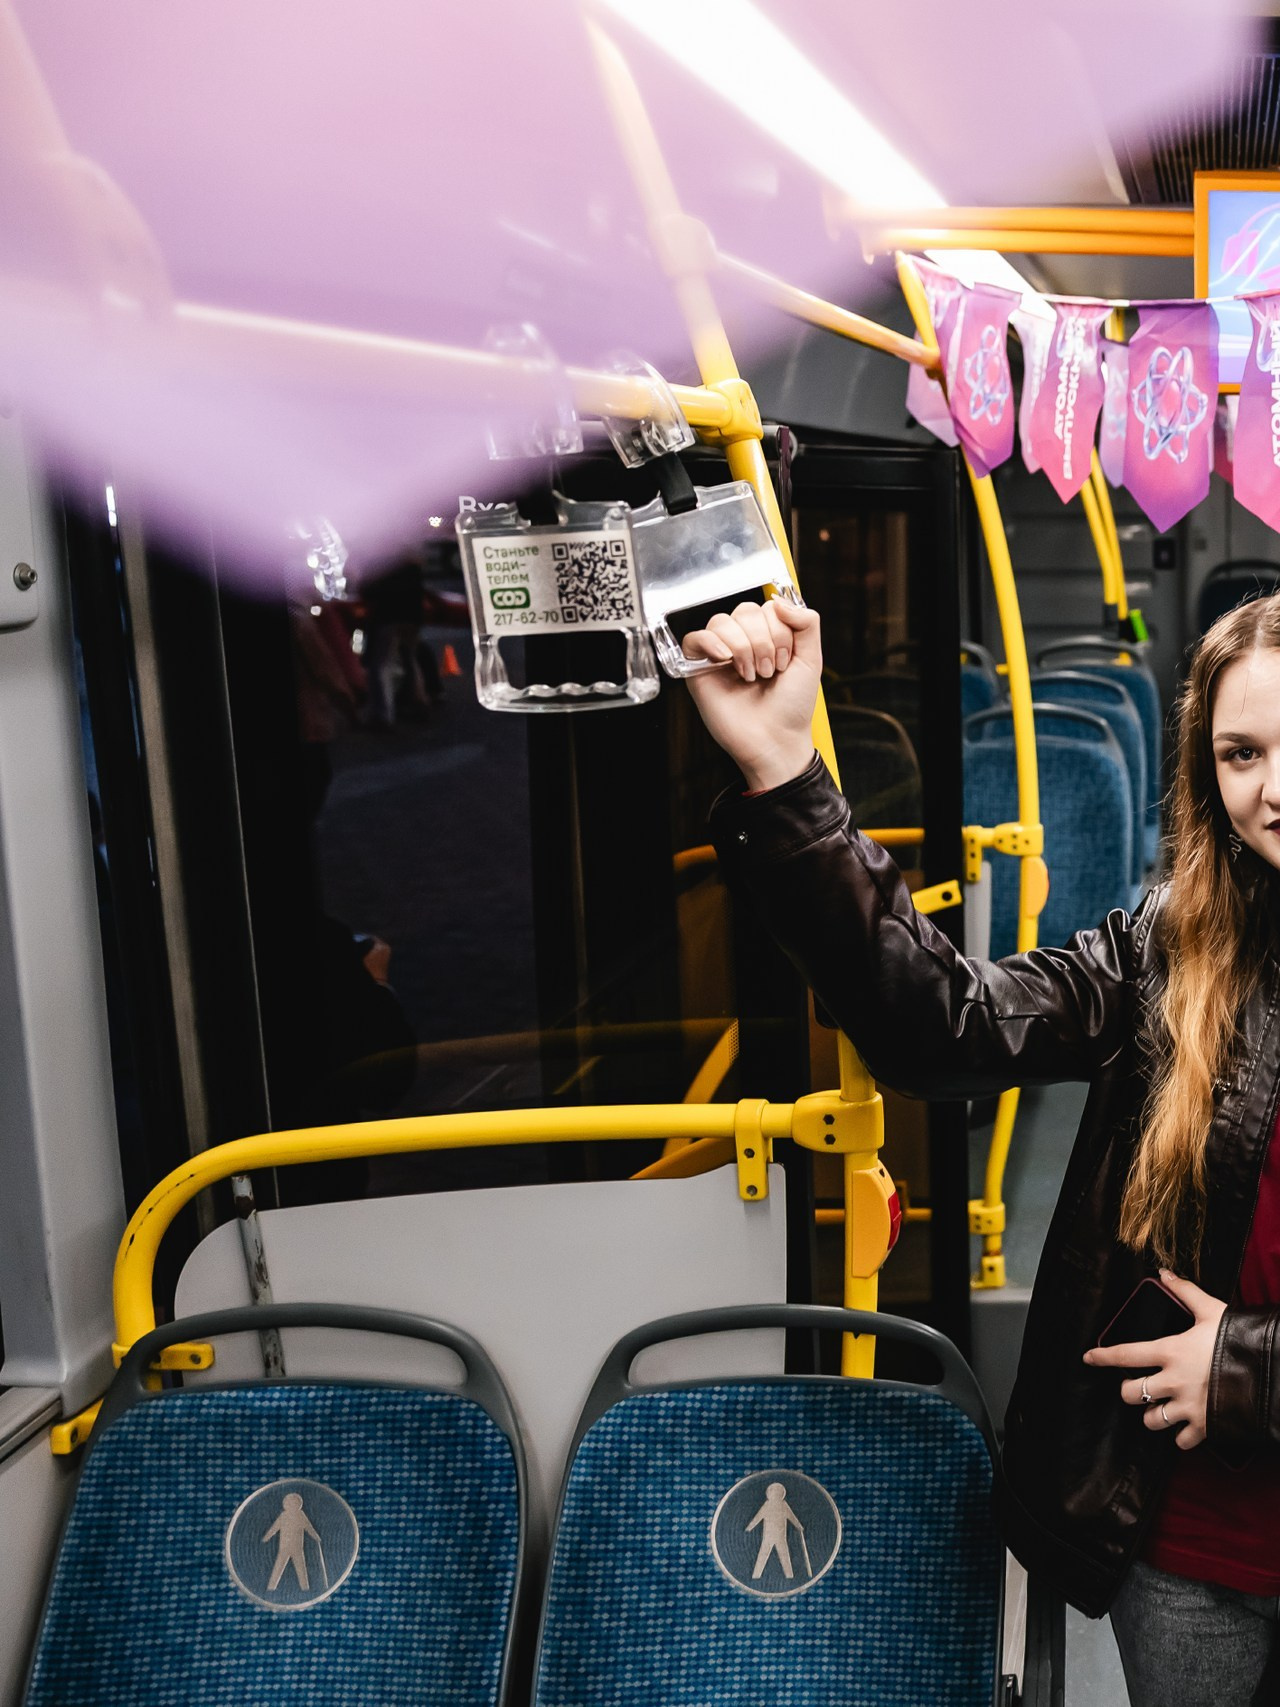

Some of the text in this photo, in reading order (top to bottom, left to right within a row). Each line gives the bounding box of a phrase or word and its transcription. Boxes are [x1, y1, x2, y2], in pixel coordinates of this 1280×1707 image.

[1054, 316, 1076, 440] АТОМНЫЙ
[1063, 317, 1087, 480] ВЫПУСКНОЙ
[483, 545, 539, 559] Станьте
[486, 560, 526, 572] води-
[487, 573, 529, 585] телем
[494, 610, 559, 626] 217-62-70
